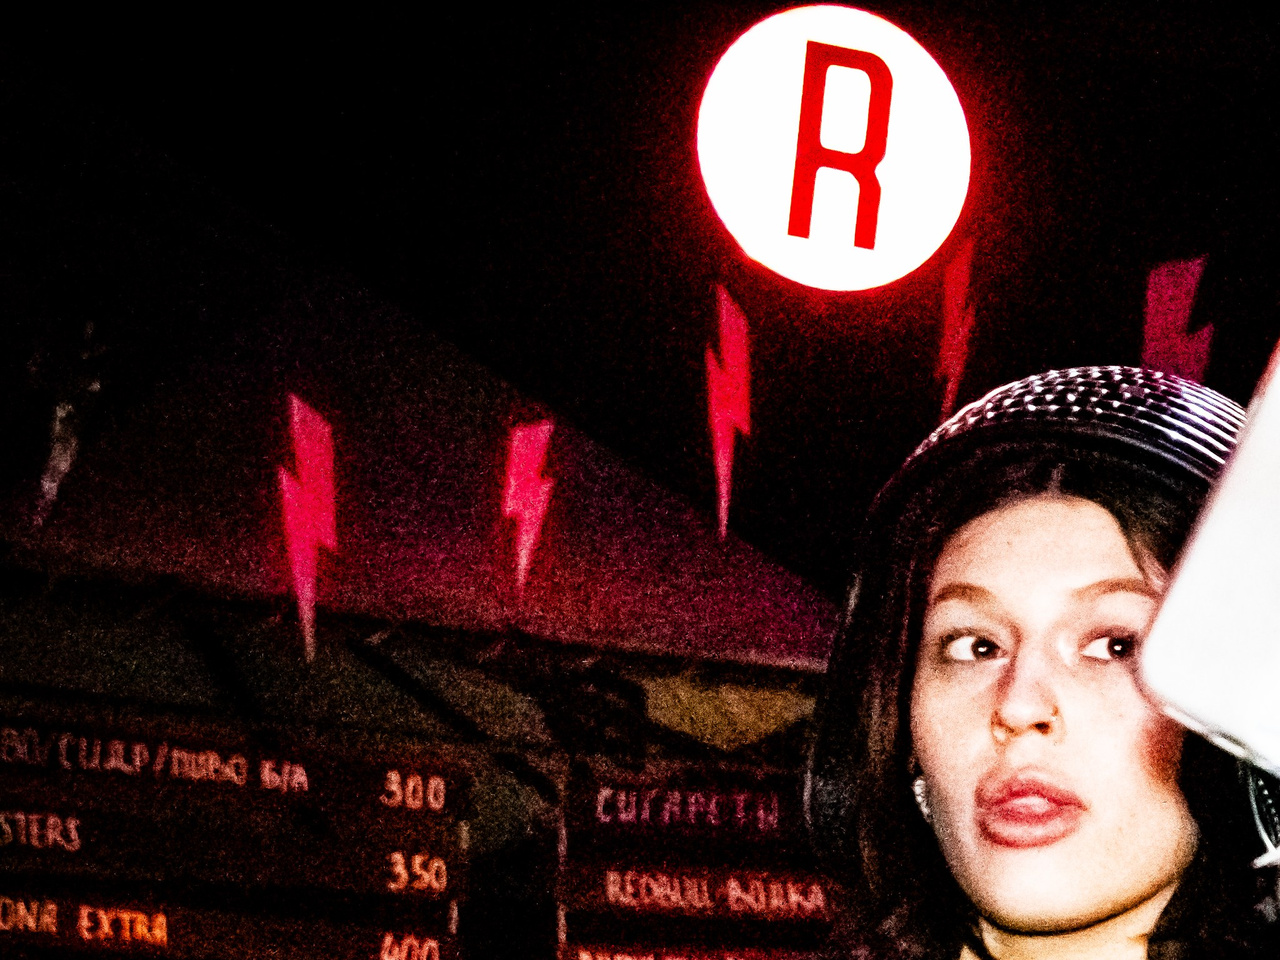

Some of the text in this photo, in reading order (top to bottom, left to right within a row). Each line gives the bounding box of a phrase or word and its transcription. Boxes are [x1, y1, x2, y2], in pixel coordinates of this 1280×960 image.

[787, 39, 894, 251] R
[378, 768, 447, 811] 300
[385, 850, 448, 894] 350
[77, 903, 169, 948] EXTRA
